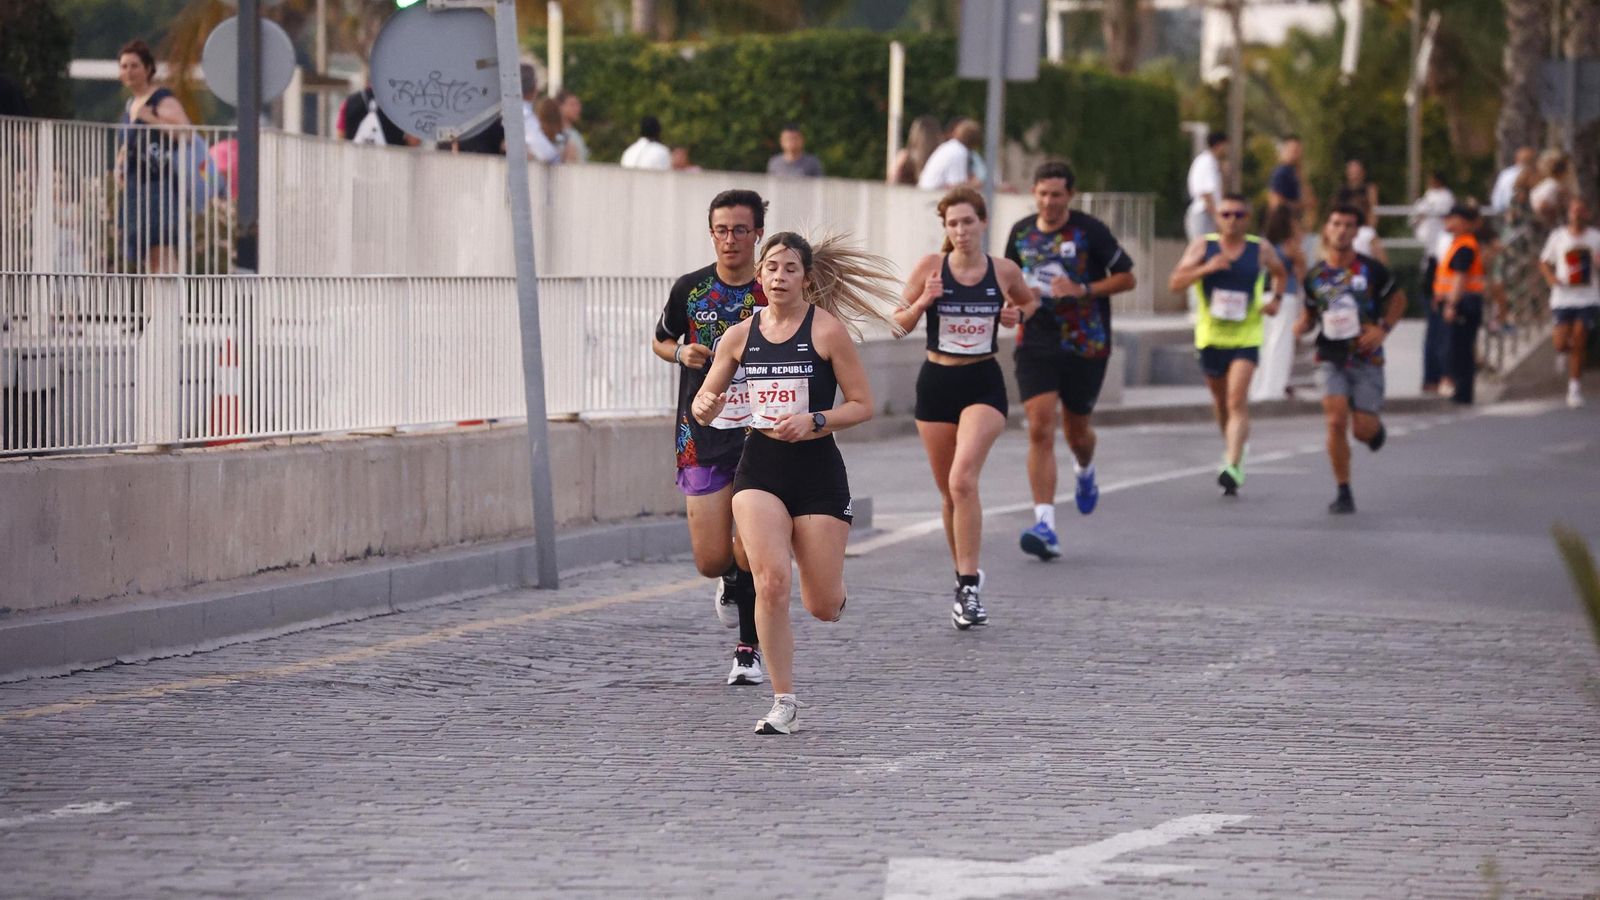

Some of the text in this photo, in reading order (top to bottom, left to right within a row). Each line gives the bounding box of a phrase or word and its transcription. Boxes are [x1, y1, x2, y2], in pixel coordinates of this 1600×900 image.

[695, 311, 718, 321] CGO
[948, 325, 986, 335] 3605
[725, 392, 750, 405] 415
[757, 389, 797, 404] 3781
